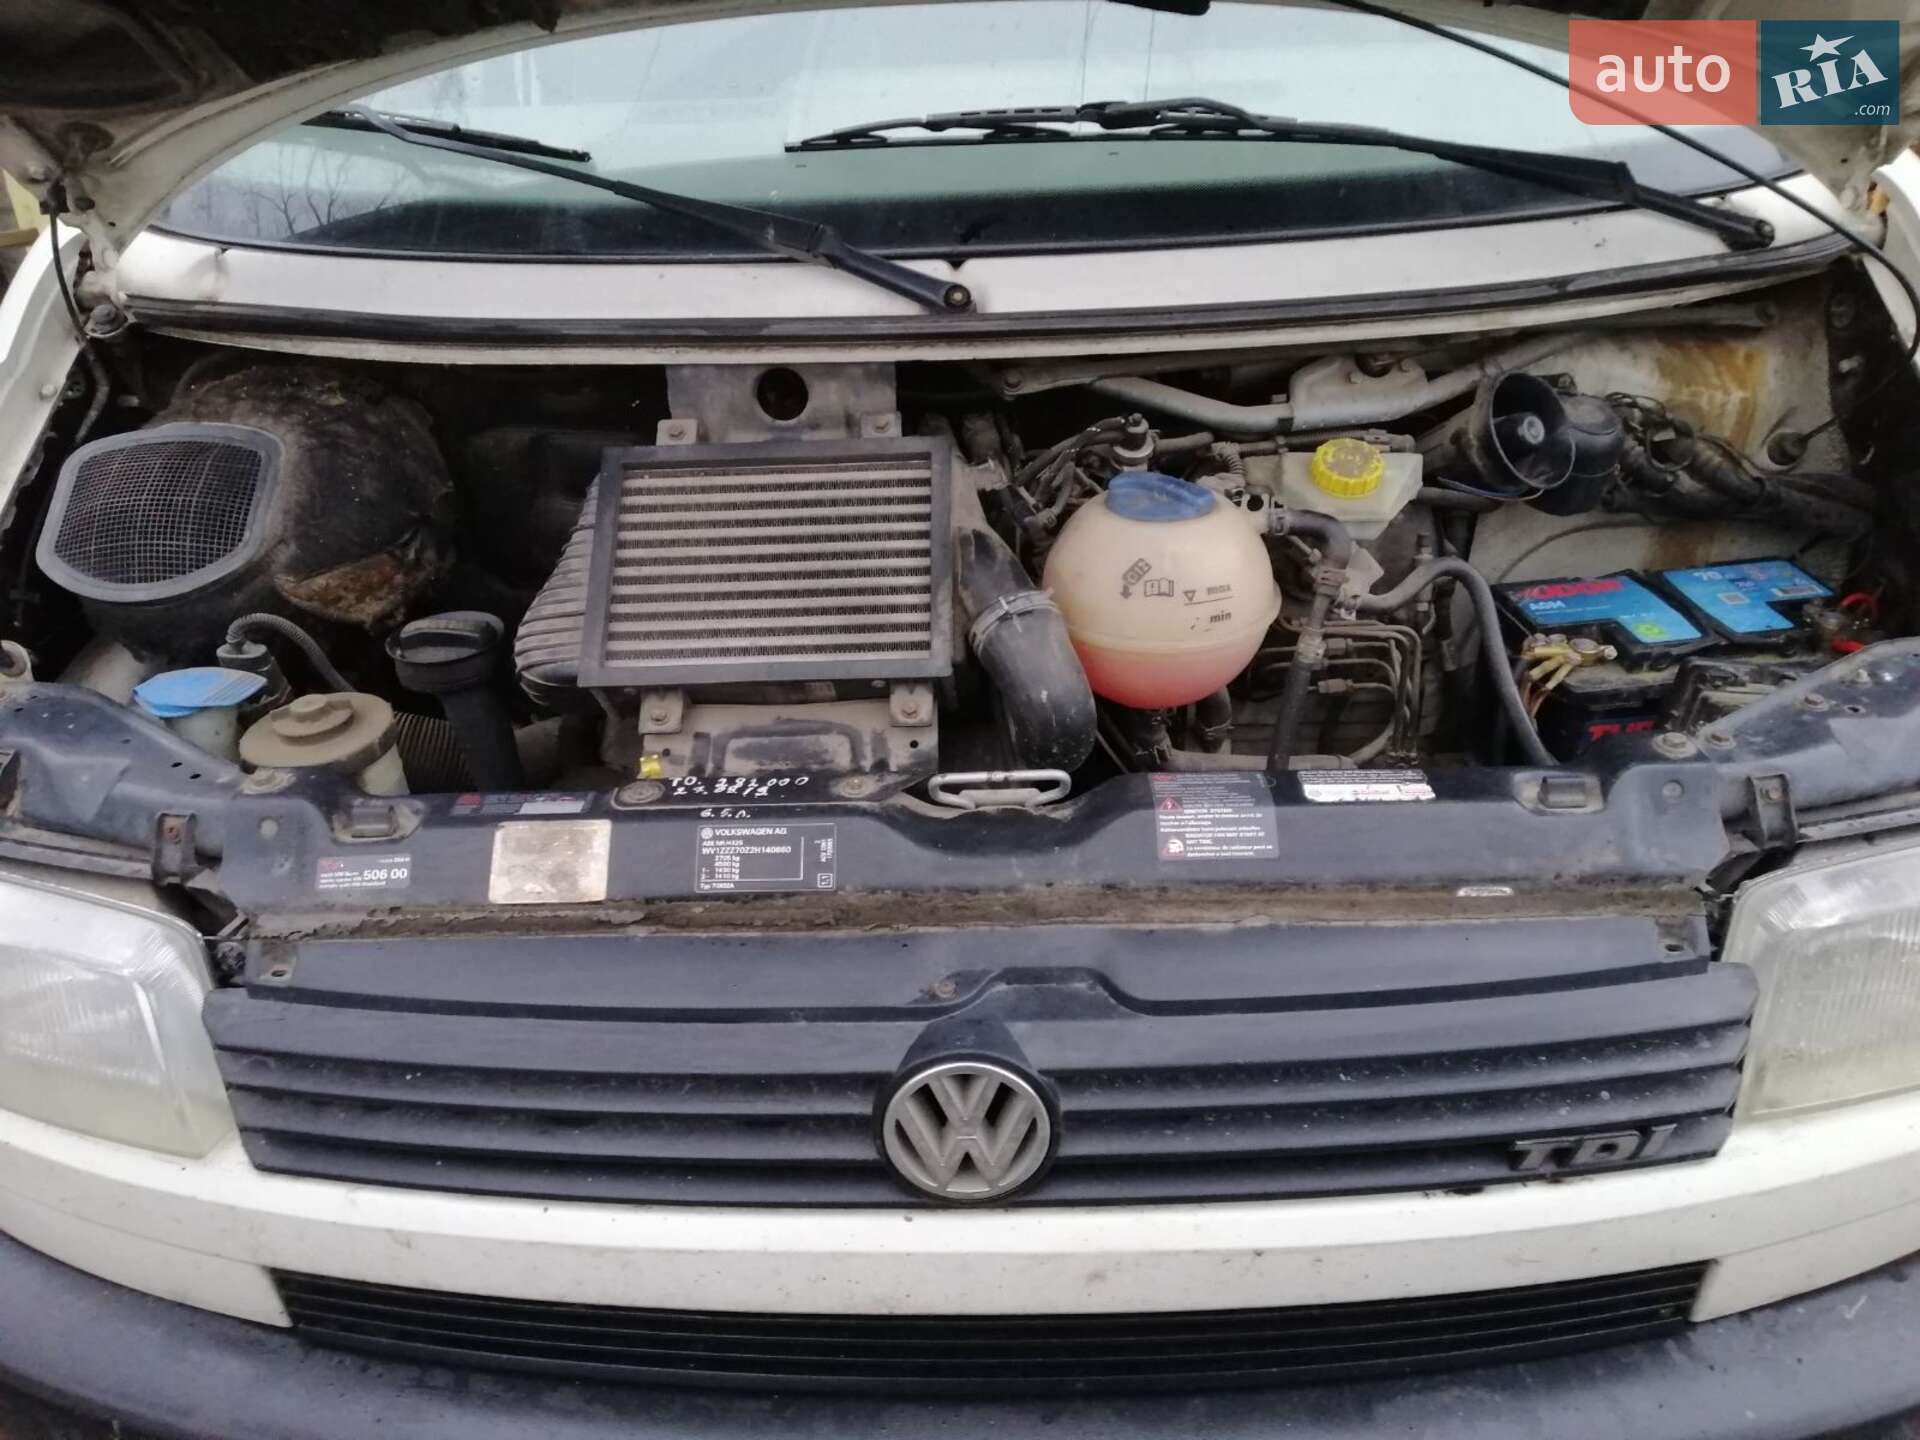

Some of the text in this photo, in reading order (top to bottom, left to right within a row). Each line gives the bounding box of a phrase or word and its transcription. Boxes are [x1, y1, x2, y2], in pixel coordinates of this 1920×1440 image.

[1209, 610, 1232, 623] min
[714, 827, 774, 837] VOLKSWAGEN
[363, 868, 388, 881] 506
[390, 867, 408, 880] 00
[1514, 1123, 1678, 1170] TDI
